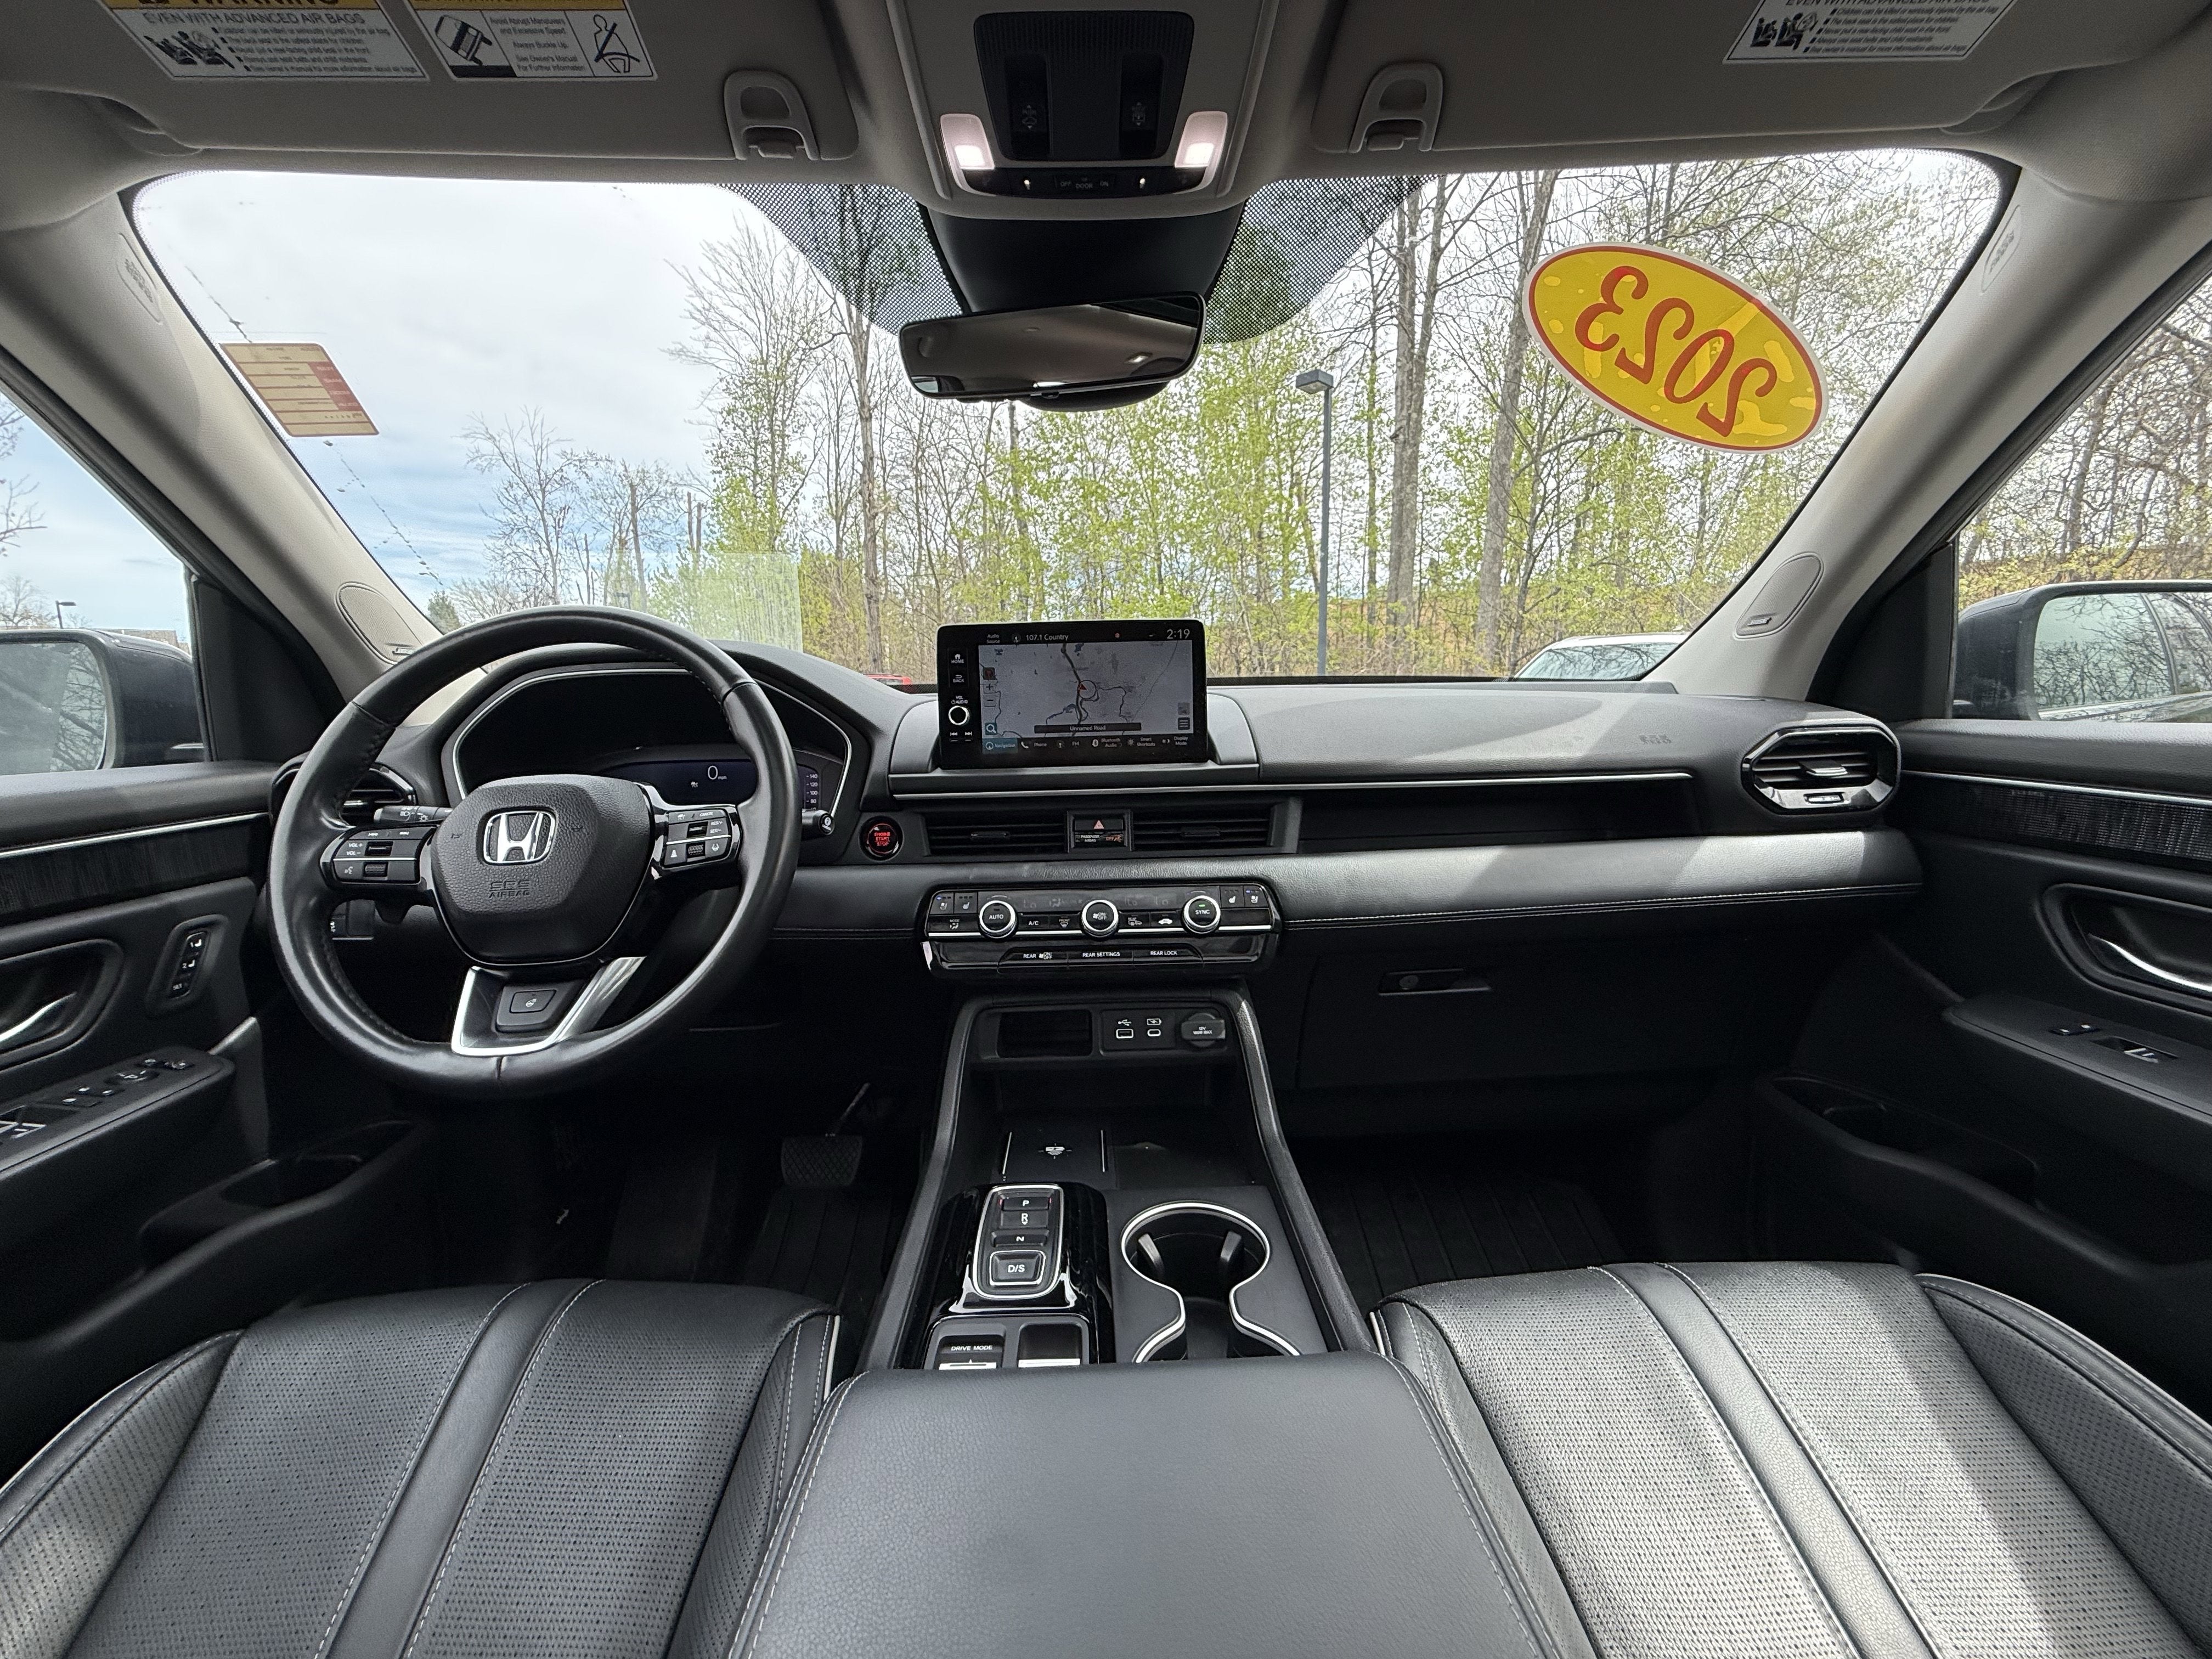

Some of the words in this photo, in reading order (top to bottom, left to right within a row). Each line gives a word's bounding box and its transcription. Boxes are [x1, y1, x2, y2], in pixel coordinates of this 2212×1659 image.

[143, 12, 185, 24] EVEN
[182, 12, 222, 24] WITH
[222, 12, 300, 24] ADVANCED
[301, 12, 325, 24] AIR
[325, 12, 365, 24] BAGS
[1167, 629, 1190, 639] 2:19
[707, 765, 718, 780] 0
[1022, 1212, 1029, 1221] R
[1008, 1265, 1025, 1273] D/S
